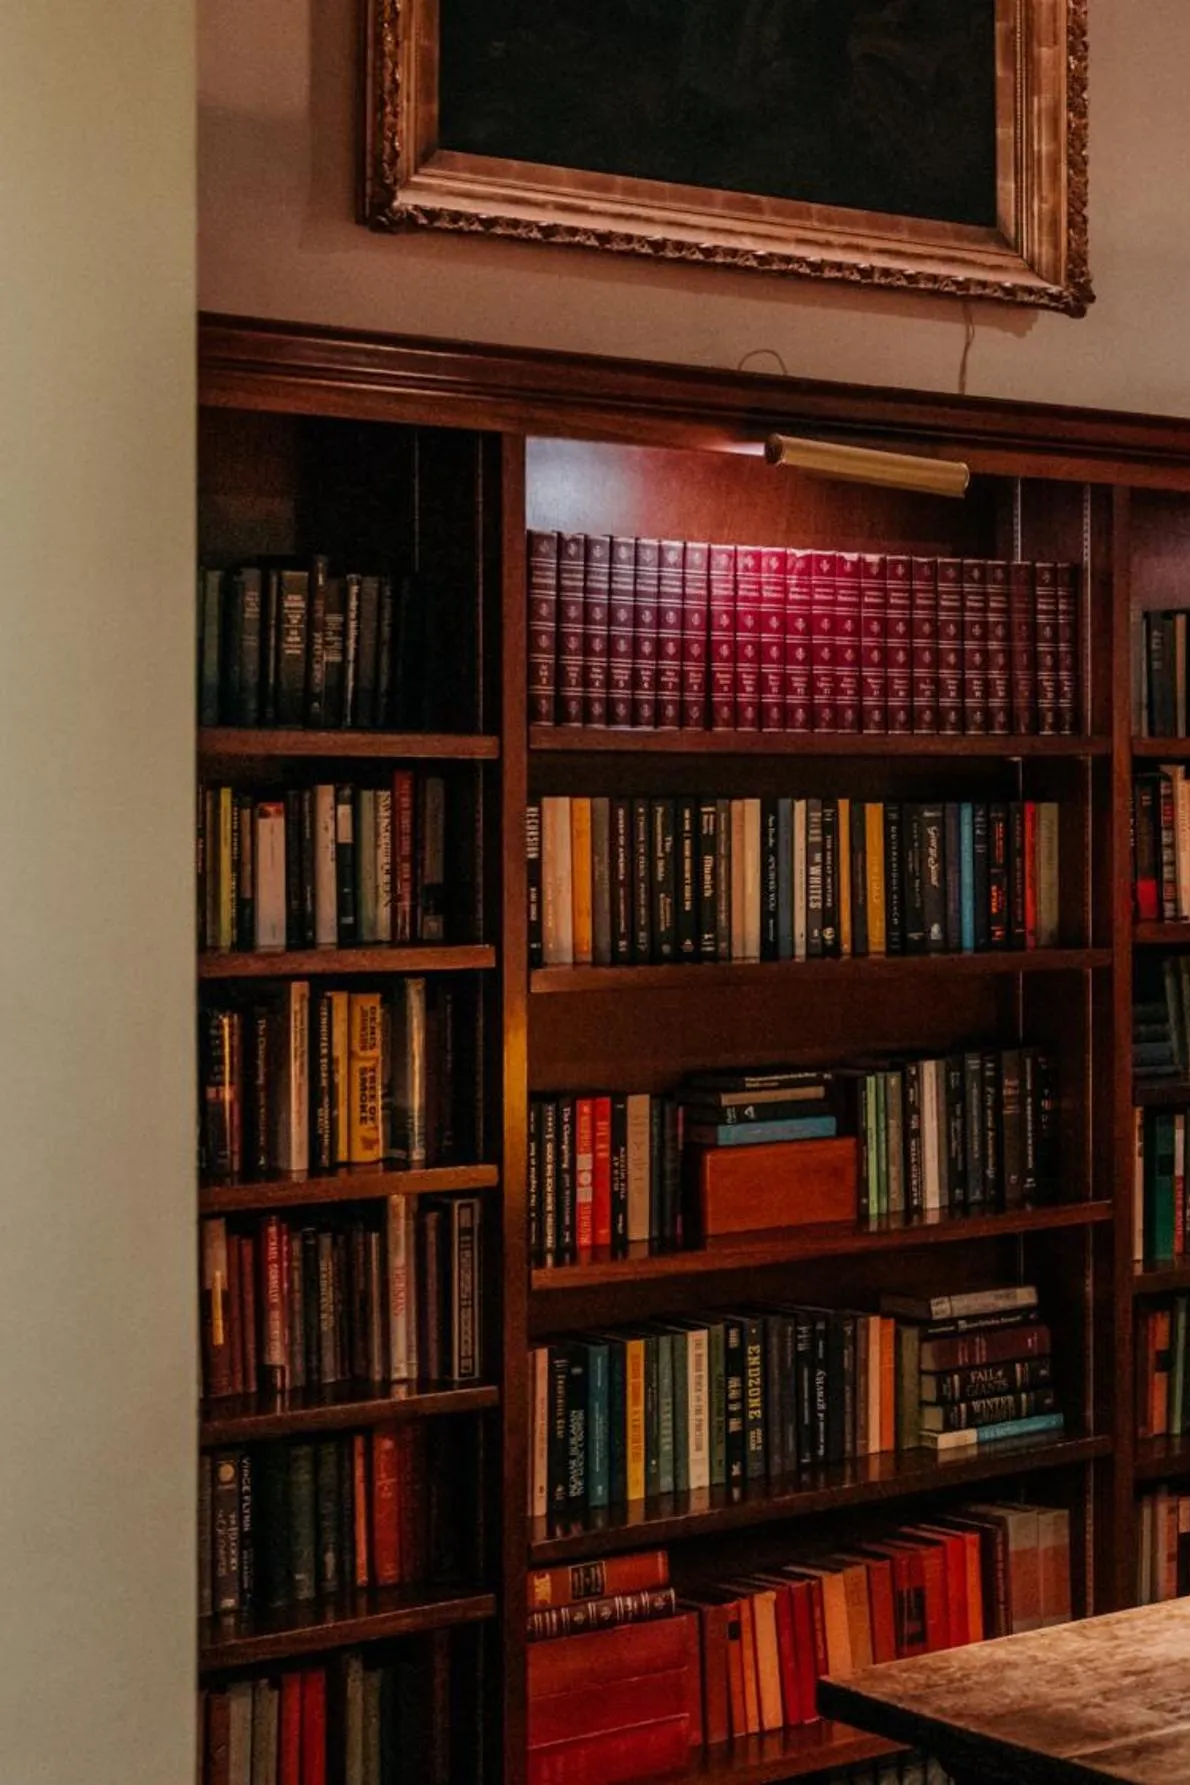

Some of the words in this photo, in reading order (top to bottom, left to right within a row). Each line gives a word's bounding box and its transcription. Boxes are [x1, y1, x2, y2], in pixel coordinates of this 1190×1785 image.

[526, 806, 541, 859] RECURSION
[703, 855, 715, 898] Munich
[808, 865, 823, 909] WHITES
[369, 1006, 378, 1051] DENIS
[359, 1067, 369, 1127] SMOKE
[369, 1067, 378, 1102] TREE
[369, 1105, 378, 1122] OF
[815, 1368, 828, 1411] gravity
[241, 1496, 252, 1532] FLYNN
